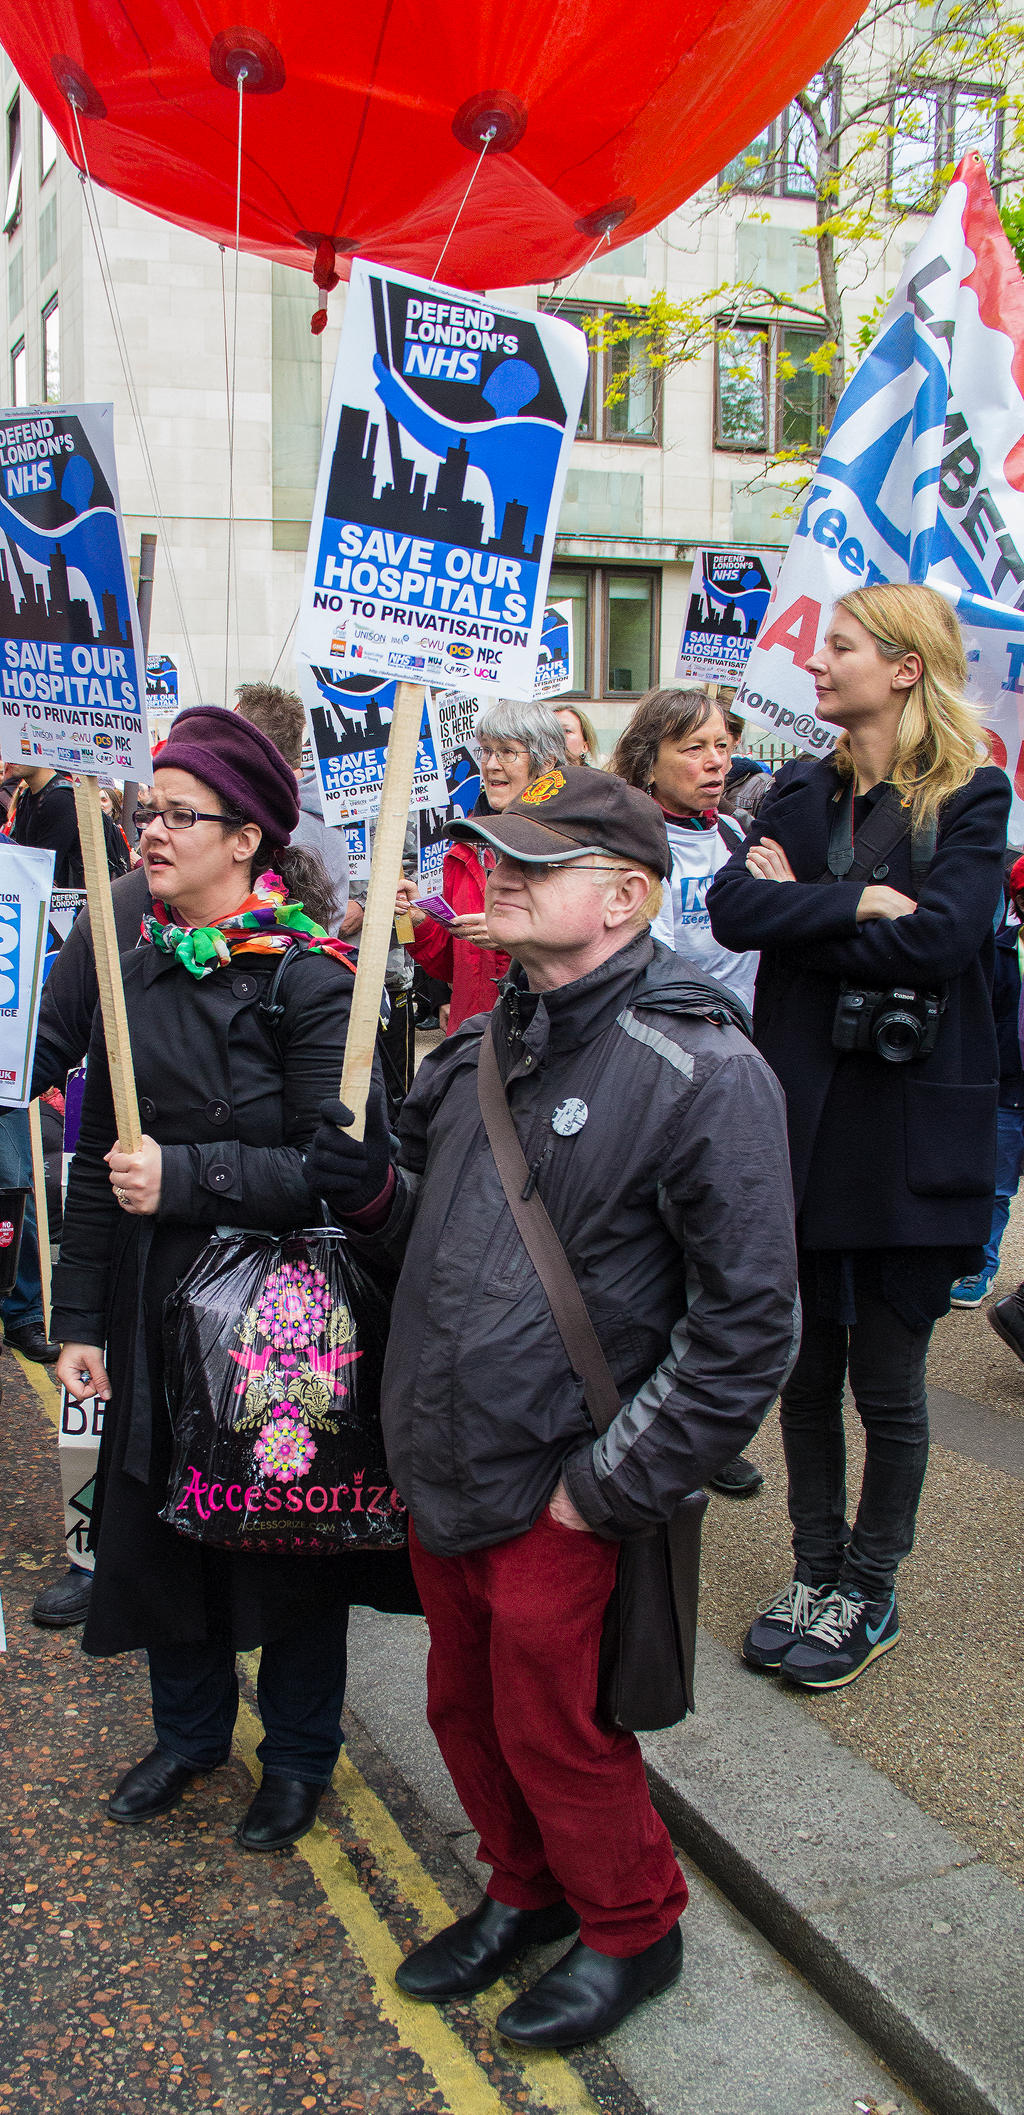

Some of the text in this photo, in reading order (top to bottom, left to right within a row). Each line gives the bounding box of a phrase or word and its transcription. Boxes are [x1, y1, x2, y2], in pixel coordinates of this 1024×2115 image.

[407, 299, 495, 331] DEFEND
[405, 319, 519, 355] LONDON'S
[405, 345, 480, 381] NHS
[0, 433, 75, 466] LONDON'S
[7, 461, 52, 497] NHS
[338, 524, 522, 591] SAVE OUR
[713, 562, 754, 570] LONDON'S
[714, 555, 745, 563] DEFEND
[713, 570, 738, 581] NHS
[323, 555, 527, 624] HOSPITALS
[313, 592, 529, 648] NO TO PRIVATISATION
[355, 630, 386, 643] UNISON
[419, 637, 444, 651] CWU
[450, 644, 471, 657] pcs
[477, 647, 503, 664] NPC
[685, 643, 752, 662] HOSPITAL
[689, 632, 757, 652] SAVE OUR
[4, 640, 128, 679] SAVE OUR
[389, 652, 411, 665] NHS
[693, 656, 702, 664] TO
[2, 669, 136, 711] HOSPITALS
[2, 701, 142, 733] NO TO PRIVATISATION
[440, 697, 479, 723] OUR NHS
[440, 714, 475, 739] IS HERE
[95, 735, 111, 746] pcs
[115, 735, 132, 751] NPC
[328, 749, 377, 773] SAVE
[325, 755, 433, 790] HOSPILS
[325, 789, 340, 801] NO
[343, 786, 357, 798] TO
[424, 838, 450, 859] SAVE
[420, 872, 429, 880] NO
[0, 893, 20, 903] ION
[51, 893, 79, 902] DEFEND
[51, 898, 87, 908] LONDON'S
[893, 992, 915, 1001] Canon
[0, 1009, 18, 1018] ICE
